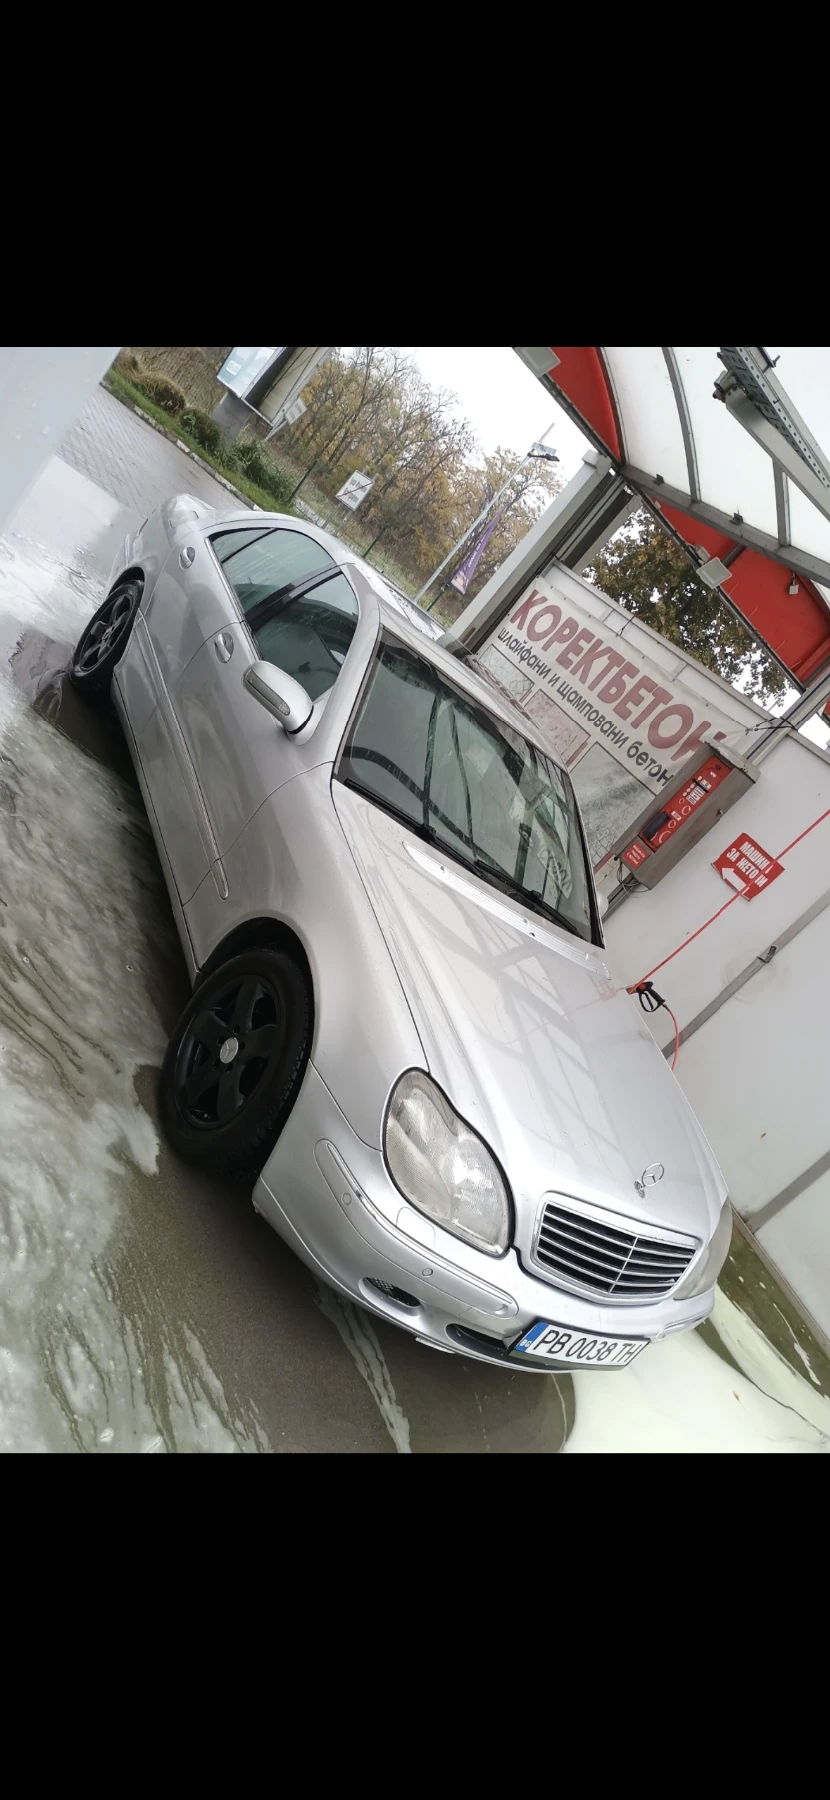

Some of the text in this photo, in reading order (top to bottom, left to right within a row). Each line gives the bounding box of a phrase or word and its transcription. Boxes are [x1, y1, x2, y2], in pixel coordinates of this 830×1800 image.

[497, 627, 550, 680] шлайфани
[547, 673, 559, 687] и
[556, 681, 631, 748] щамповани
[626, 740, 674, 786] бетон
[726, 847, 740, 862] ЗА
[519, 1339, 532, 1348] BG
[533, 1329, 642, 1363] PB 0038 TH
